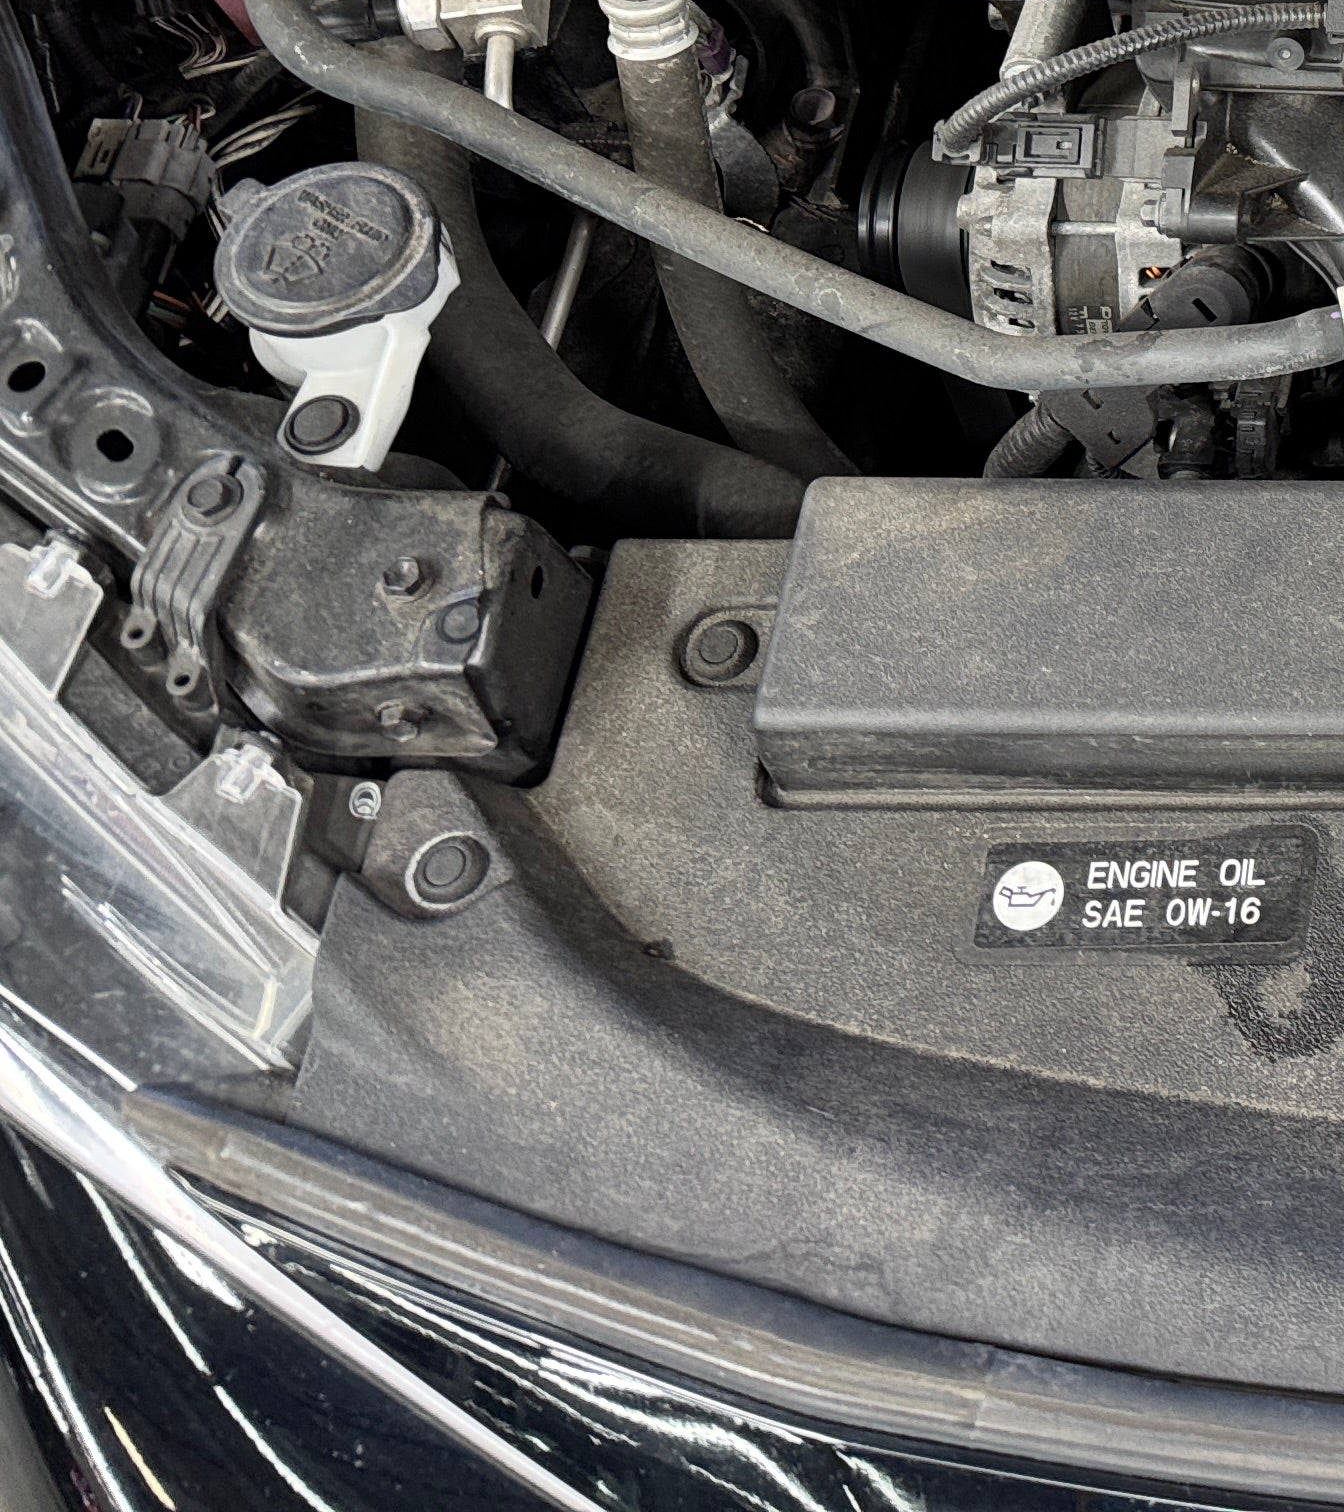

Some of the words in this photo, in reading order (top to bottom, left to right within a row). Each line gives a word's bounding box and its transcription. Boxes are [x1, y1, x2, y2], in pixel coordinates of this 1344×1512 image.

[1087, 859, 1199, 890] ENGINE
[1219, 858, 1266, 887] OIL
[1082, 898, 1146, 929] SAE
[1166, 896, 1262, 927] 0W-16
